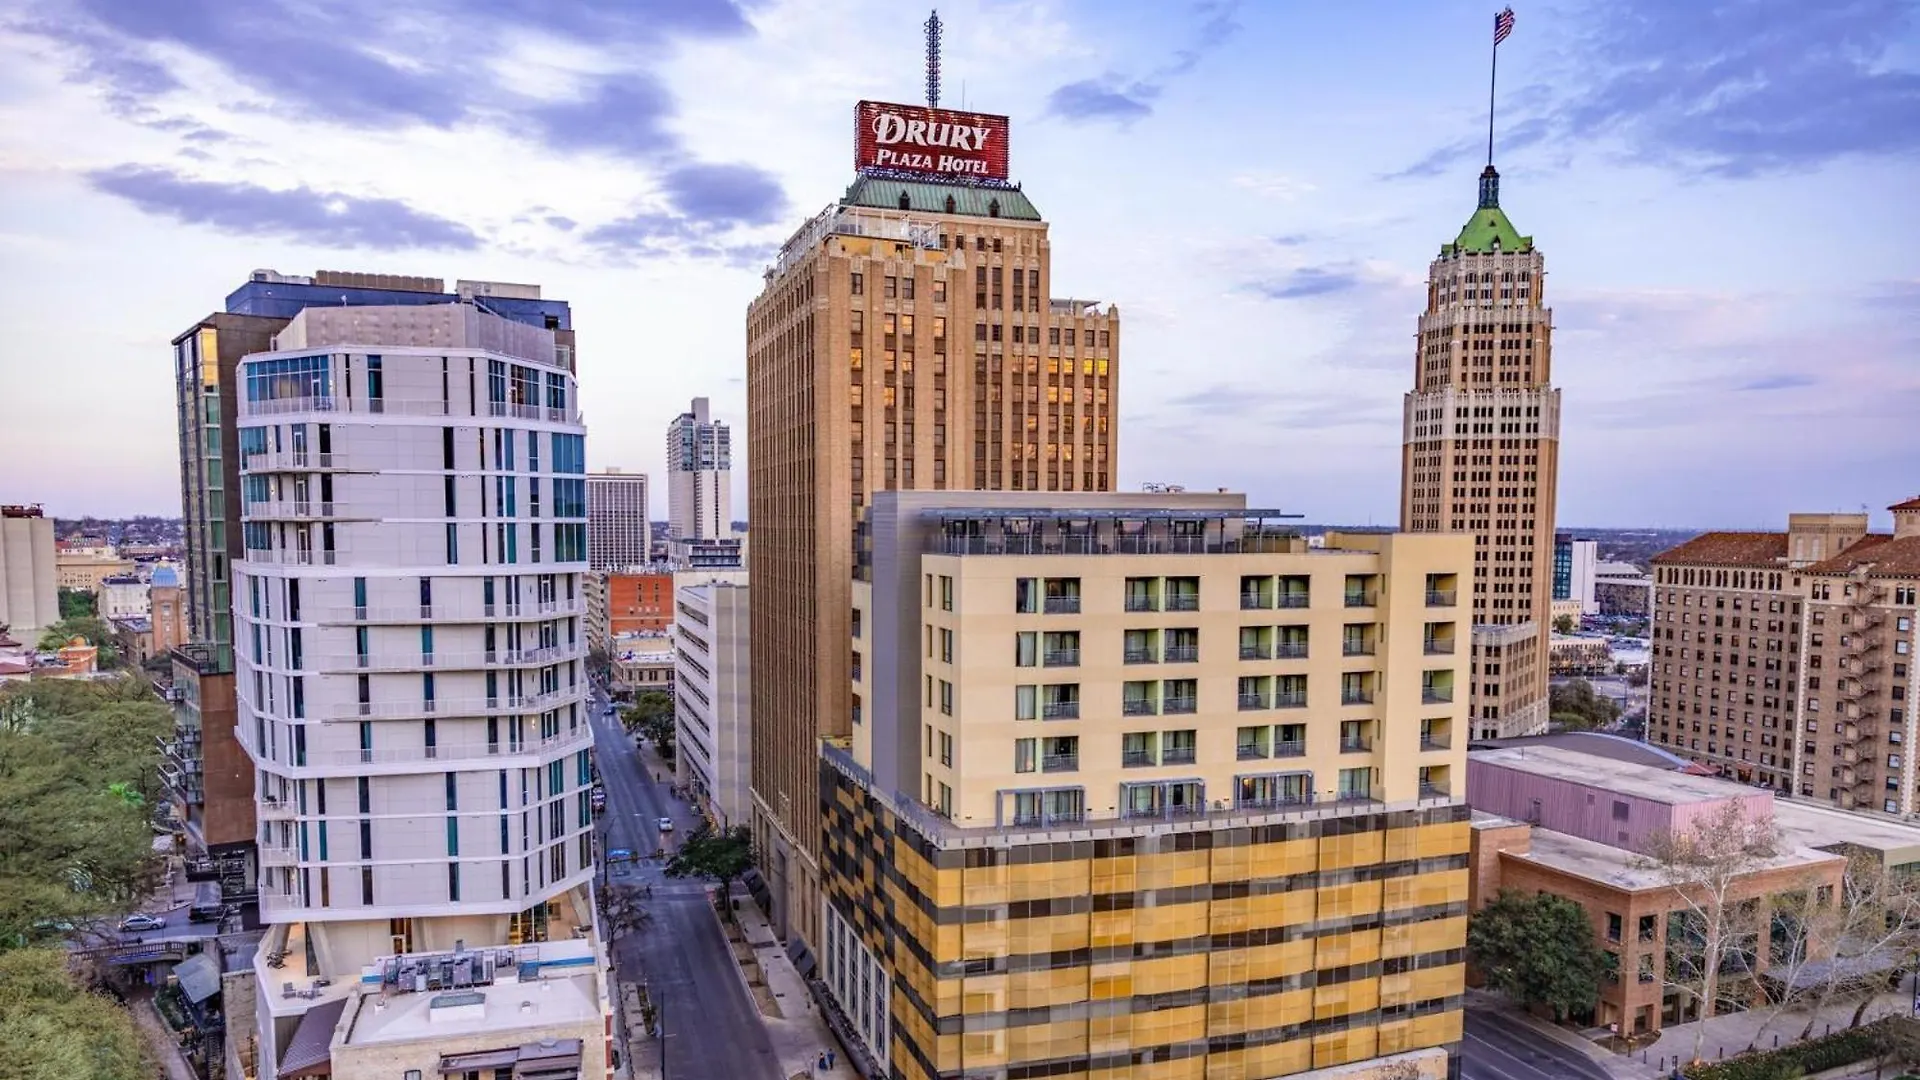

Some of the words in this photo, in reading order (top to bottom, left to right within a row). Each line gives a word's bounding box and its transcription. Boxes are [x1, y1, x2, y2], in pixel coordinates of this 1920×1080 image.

[872, 113, 992, 151] DRURY
[876, 149, 933, 168] PLAZA
[937, 155, 989, 174] HOTEL
